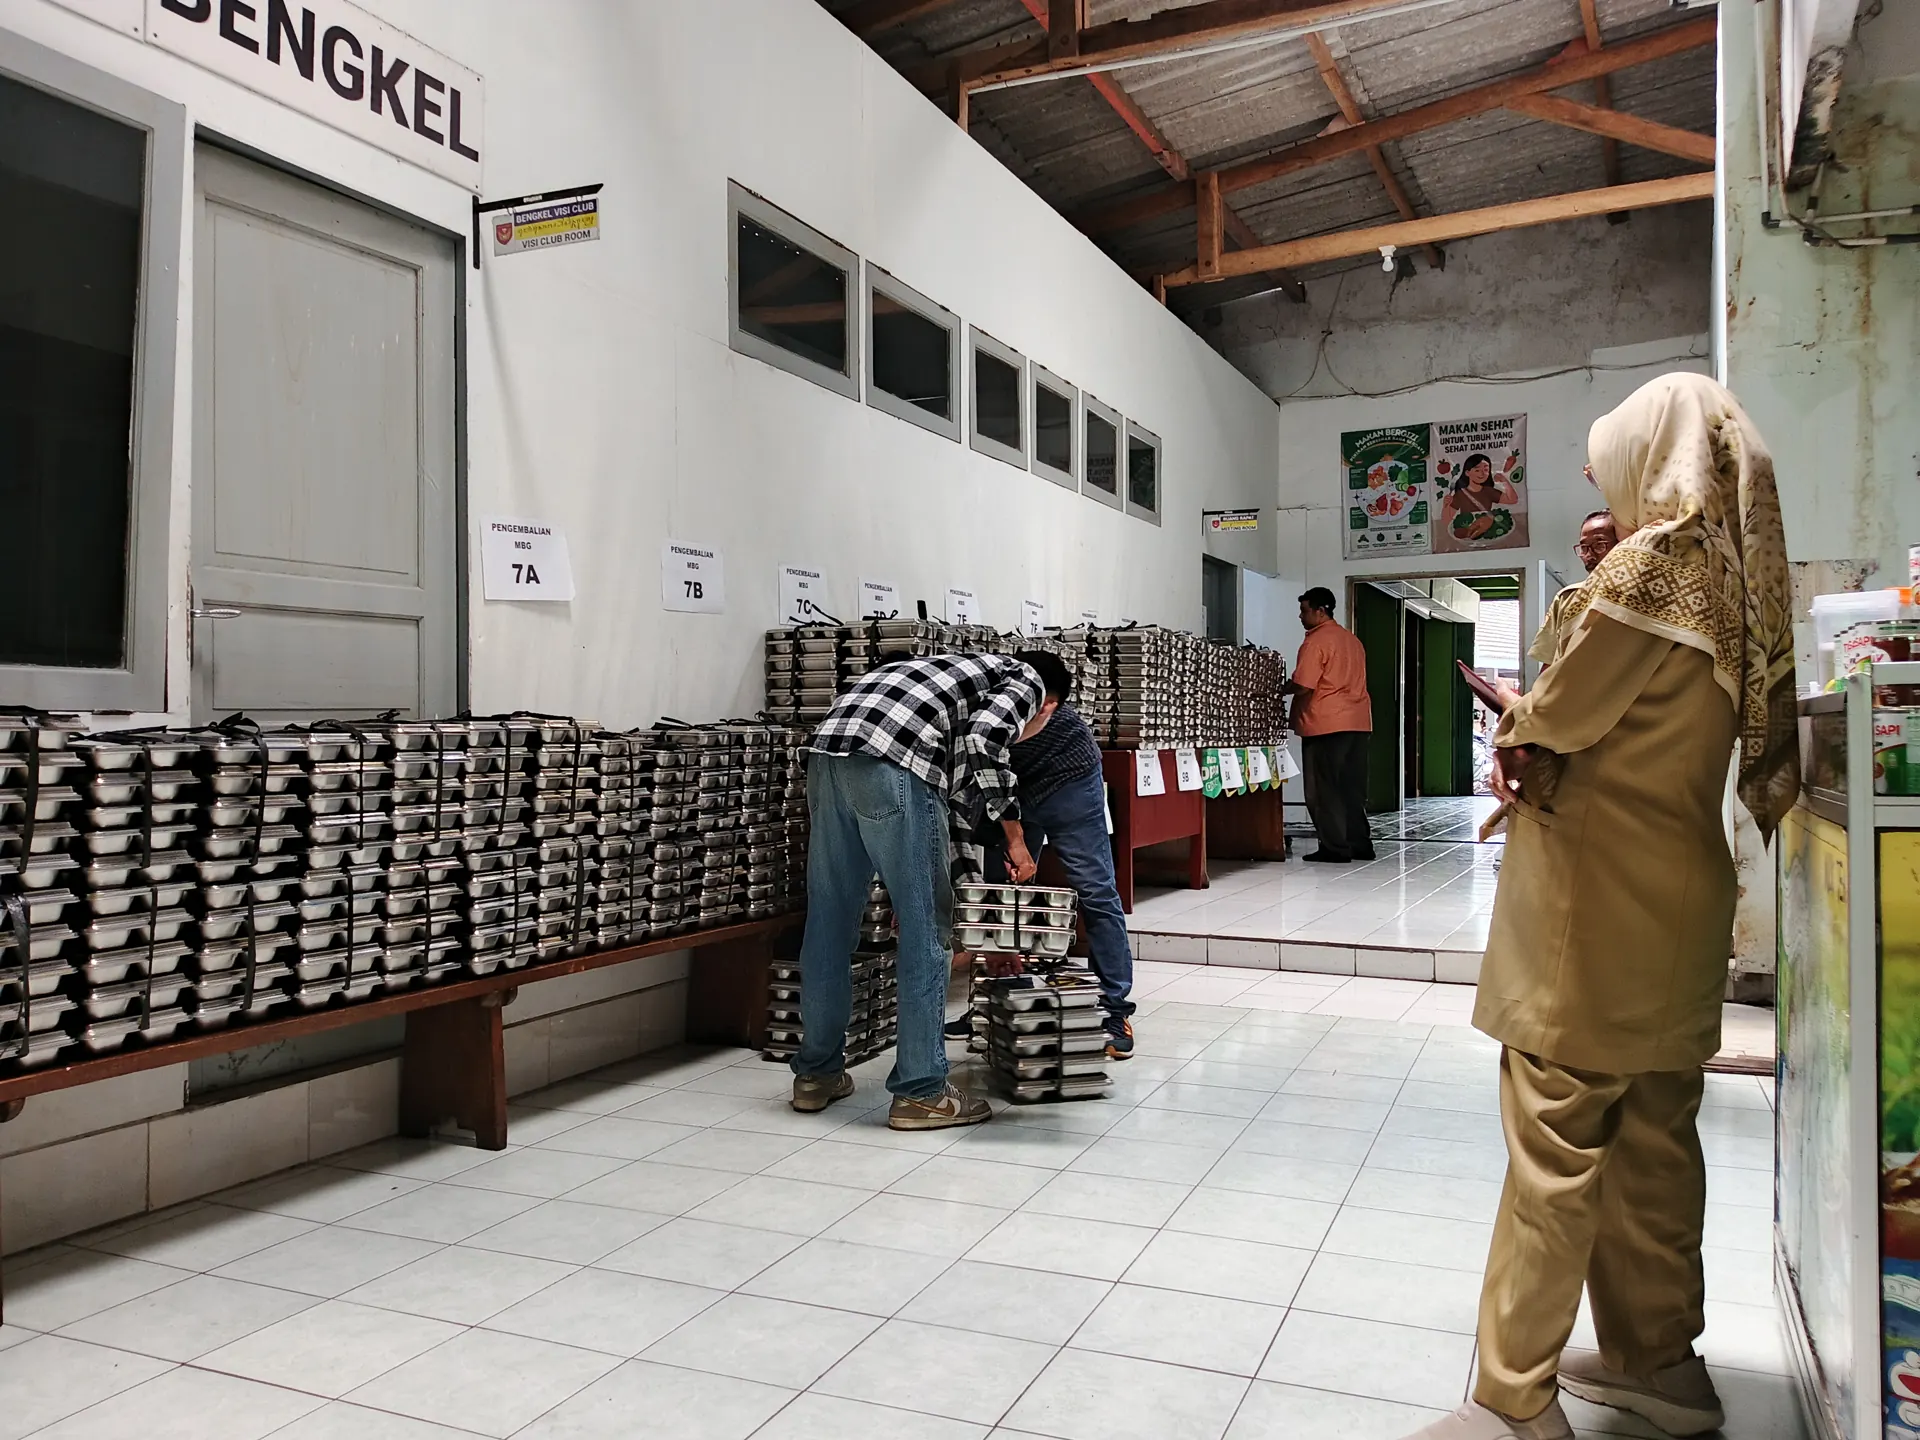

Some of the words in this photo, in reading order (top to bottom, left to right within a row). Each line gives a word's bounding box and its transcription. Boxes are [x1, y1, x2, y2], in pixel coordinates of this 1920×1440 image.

[516, 210, 553, 223] BENGKEL
[554, 207, 571, 216] VISI
[572, 202, 594, 212] CLUB
[522, 239, 538, 249] VISI
[541, 235, 562, 246] CLUB
[565, 230, 591, 242] ROOM
[1439, 422, 1478, 435] MAKAN
[1481, 419, 1514, 431] SEHAT
[1355, 430, 1384, 448] MAKAN
[1385, 428, 1419, 442] BERGIZI
[1440, 435, 1464, 445] UNTUK
[1466, 433, 1491, 443] TUBUH
[1493, 431, 1513, 439] YANG
[1445, 444, 1468, 453] SEHAT
[1470, 442, 1486, 451] DAN
[1488, 440, 1508, 449] KUAT
[491, 523, 551, 536] PENGEMBALIAN
[514, 541, 532, 549] MBG
[671, 545, 714, 559] PENGEMBALIAN
[687, 562, 699, 570] MBG
[512, 564, 540, 584] 7A
[786, 568, 820, 579] PENGEMBALIAN
[684, 580, 703, 599] 7B
[864, 582, 893, 592] PENGEMBALIAN
[796, 599, 812, 615] 7C
[1875, 725, 1901, 736] SAPI
[1143, 775, 1151, 787] 9C
